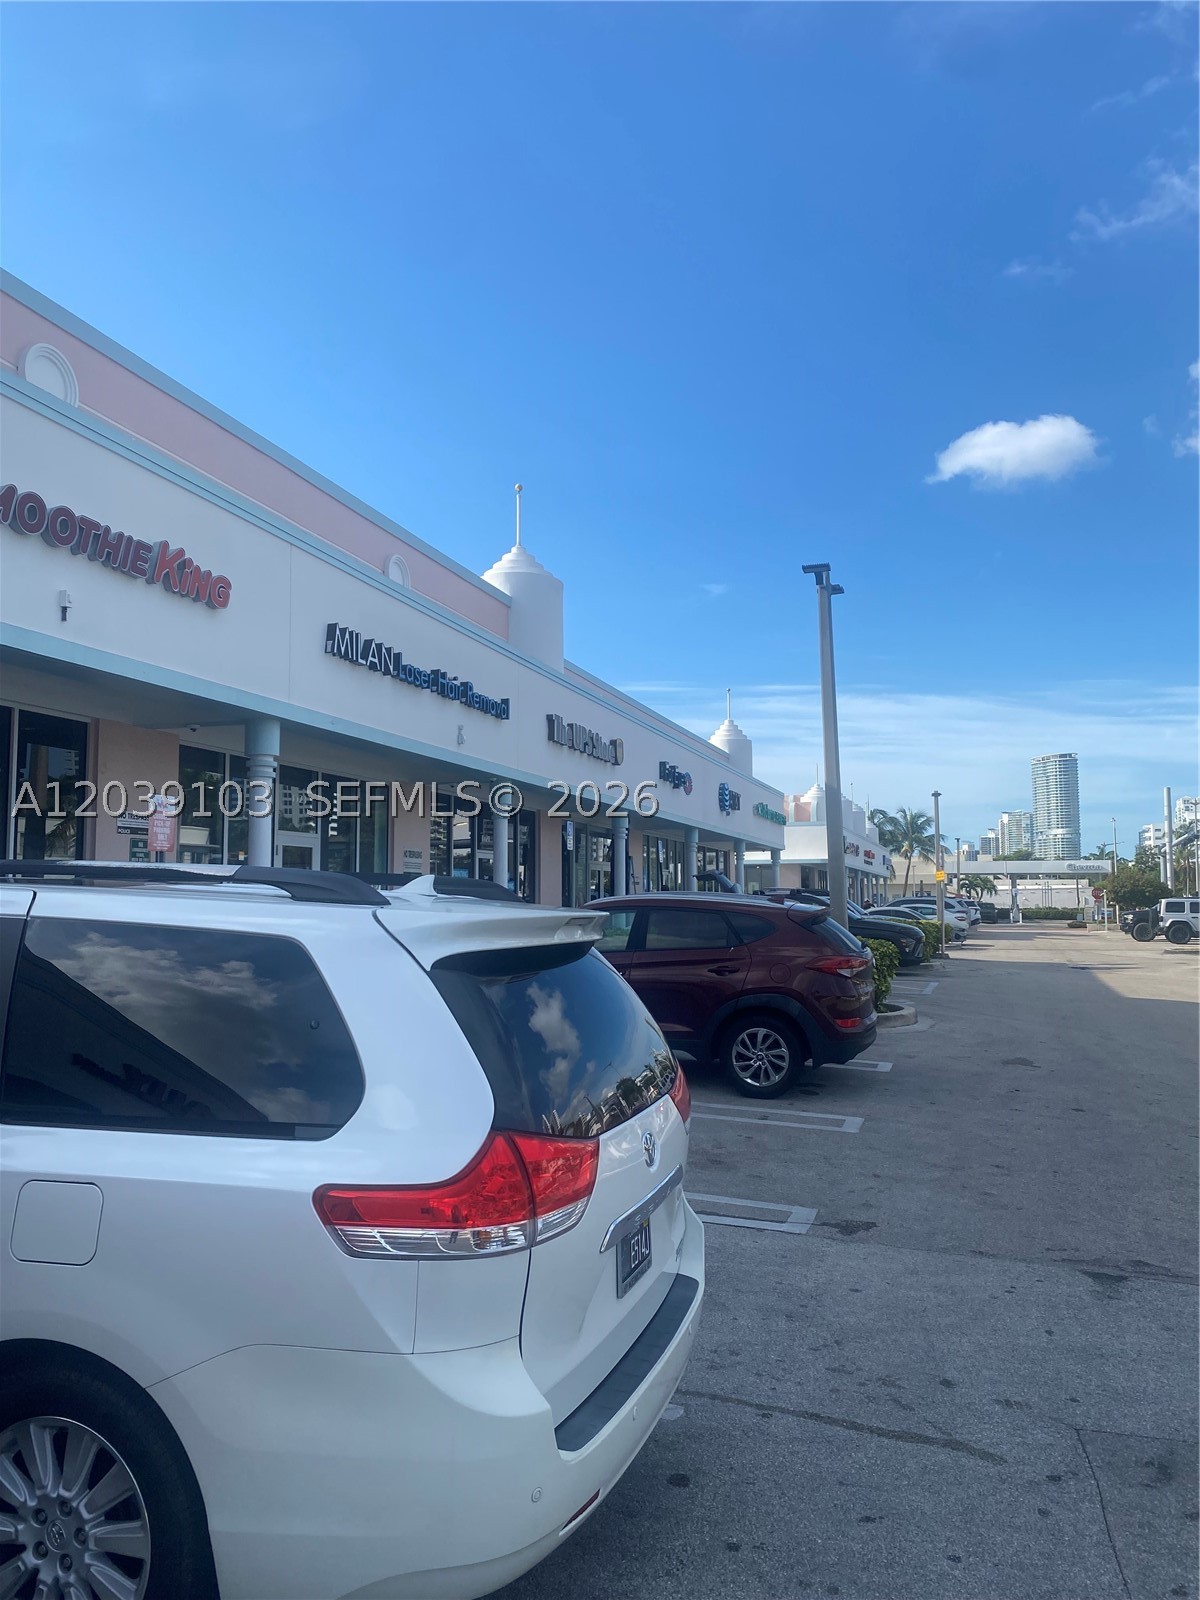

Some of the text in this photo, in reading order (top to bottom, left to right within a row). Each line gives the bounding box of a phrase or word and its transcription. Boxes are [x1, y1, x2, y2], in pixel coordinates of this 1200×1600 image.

[329, 623, 395, 676] MILAN
[397, 652, 435, 690] Laser
[436, 670, 465, 701] Hair
[547, 713, 573, 749] The
[572, 723, 594, 755] UPS
[1066, 863, 1102, 871] Chevron
